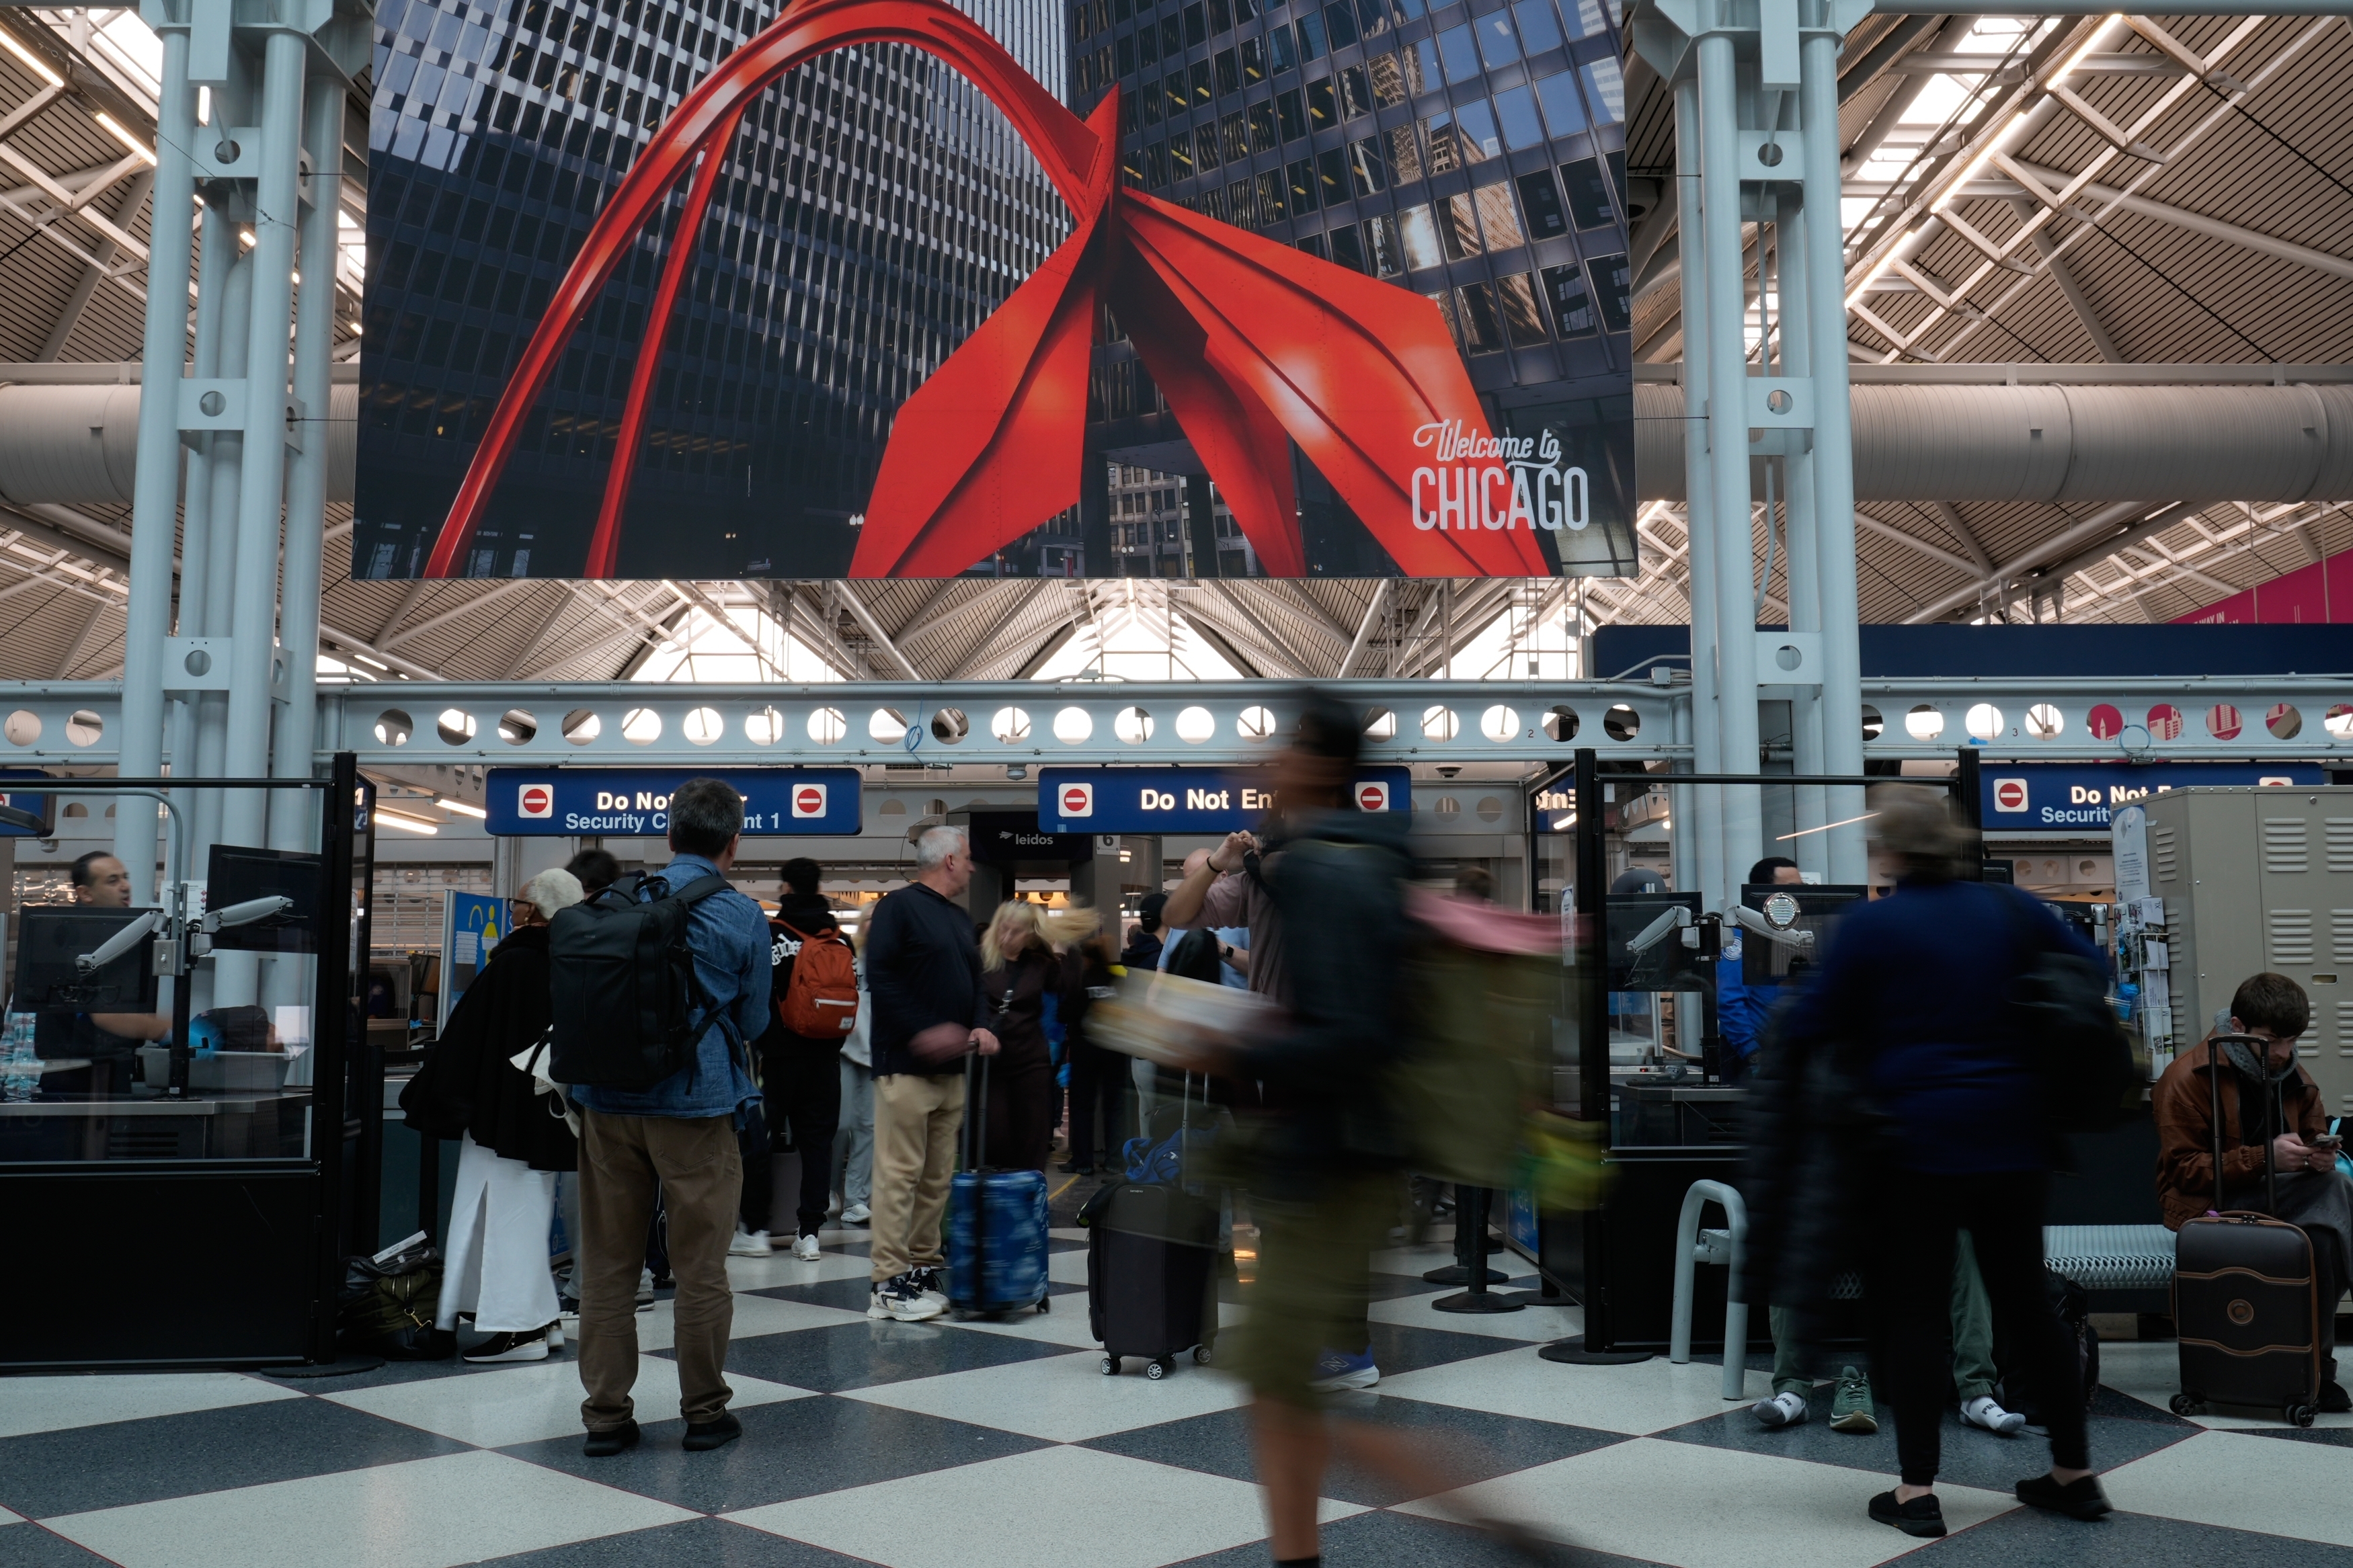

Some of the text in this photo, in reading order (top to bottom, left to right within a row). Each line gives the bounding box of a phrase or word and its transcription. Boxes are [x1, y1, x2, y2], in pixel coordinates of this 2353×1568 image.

[1412, 419, 1534, 462] Welcome
[1412, 466, 1589, 531] CHICAGO
[1527, 729, 1534, 738] 2
[2012, 728, 2018, 737] 3
[597, 792, 629, 810] Do
[1142, 789, 1175, 810] Do
[1187, 789, 1230, 810] Not
[2071, 786, 2101, 804] Do
[2110, 786, 2149, 803] Not
[565, 813, 645, 833] Security
[771, 813, 779, 829] 1
[1015, 833, 1053, 845] leidos
[1103, 835, 1114, 847] 6
